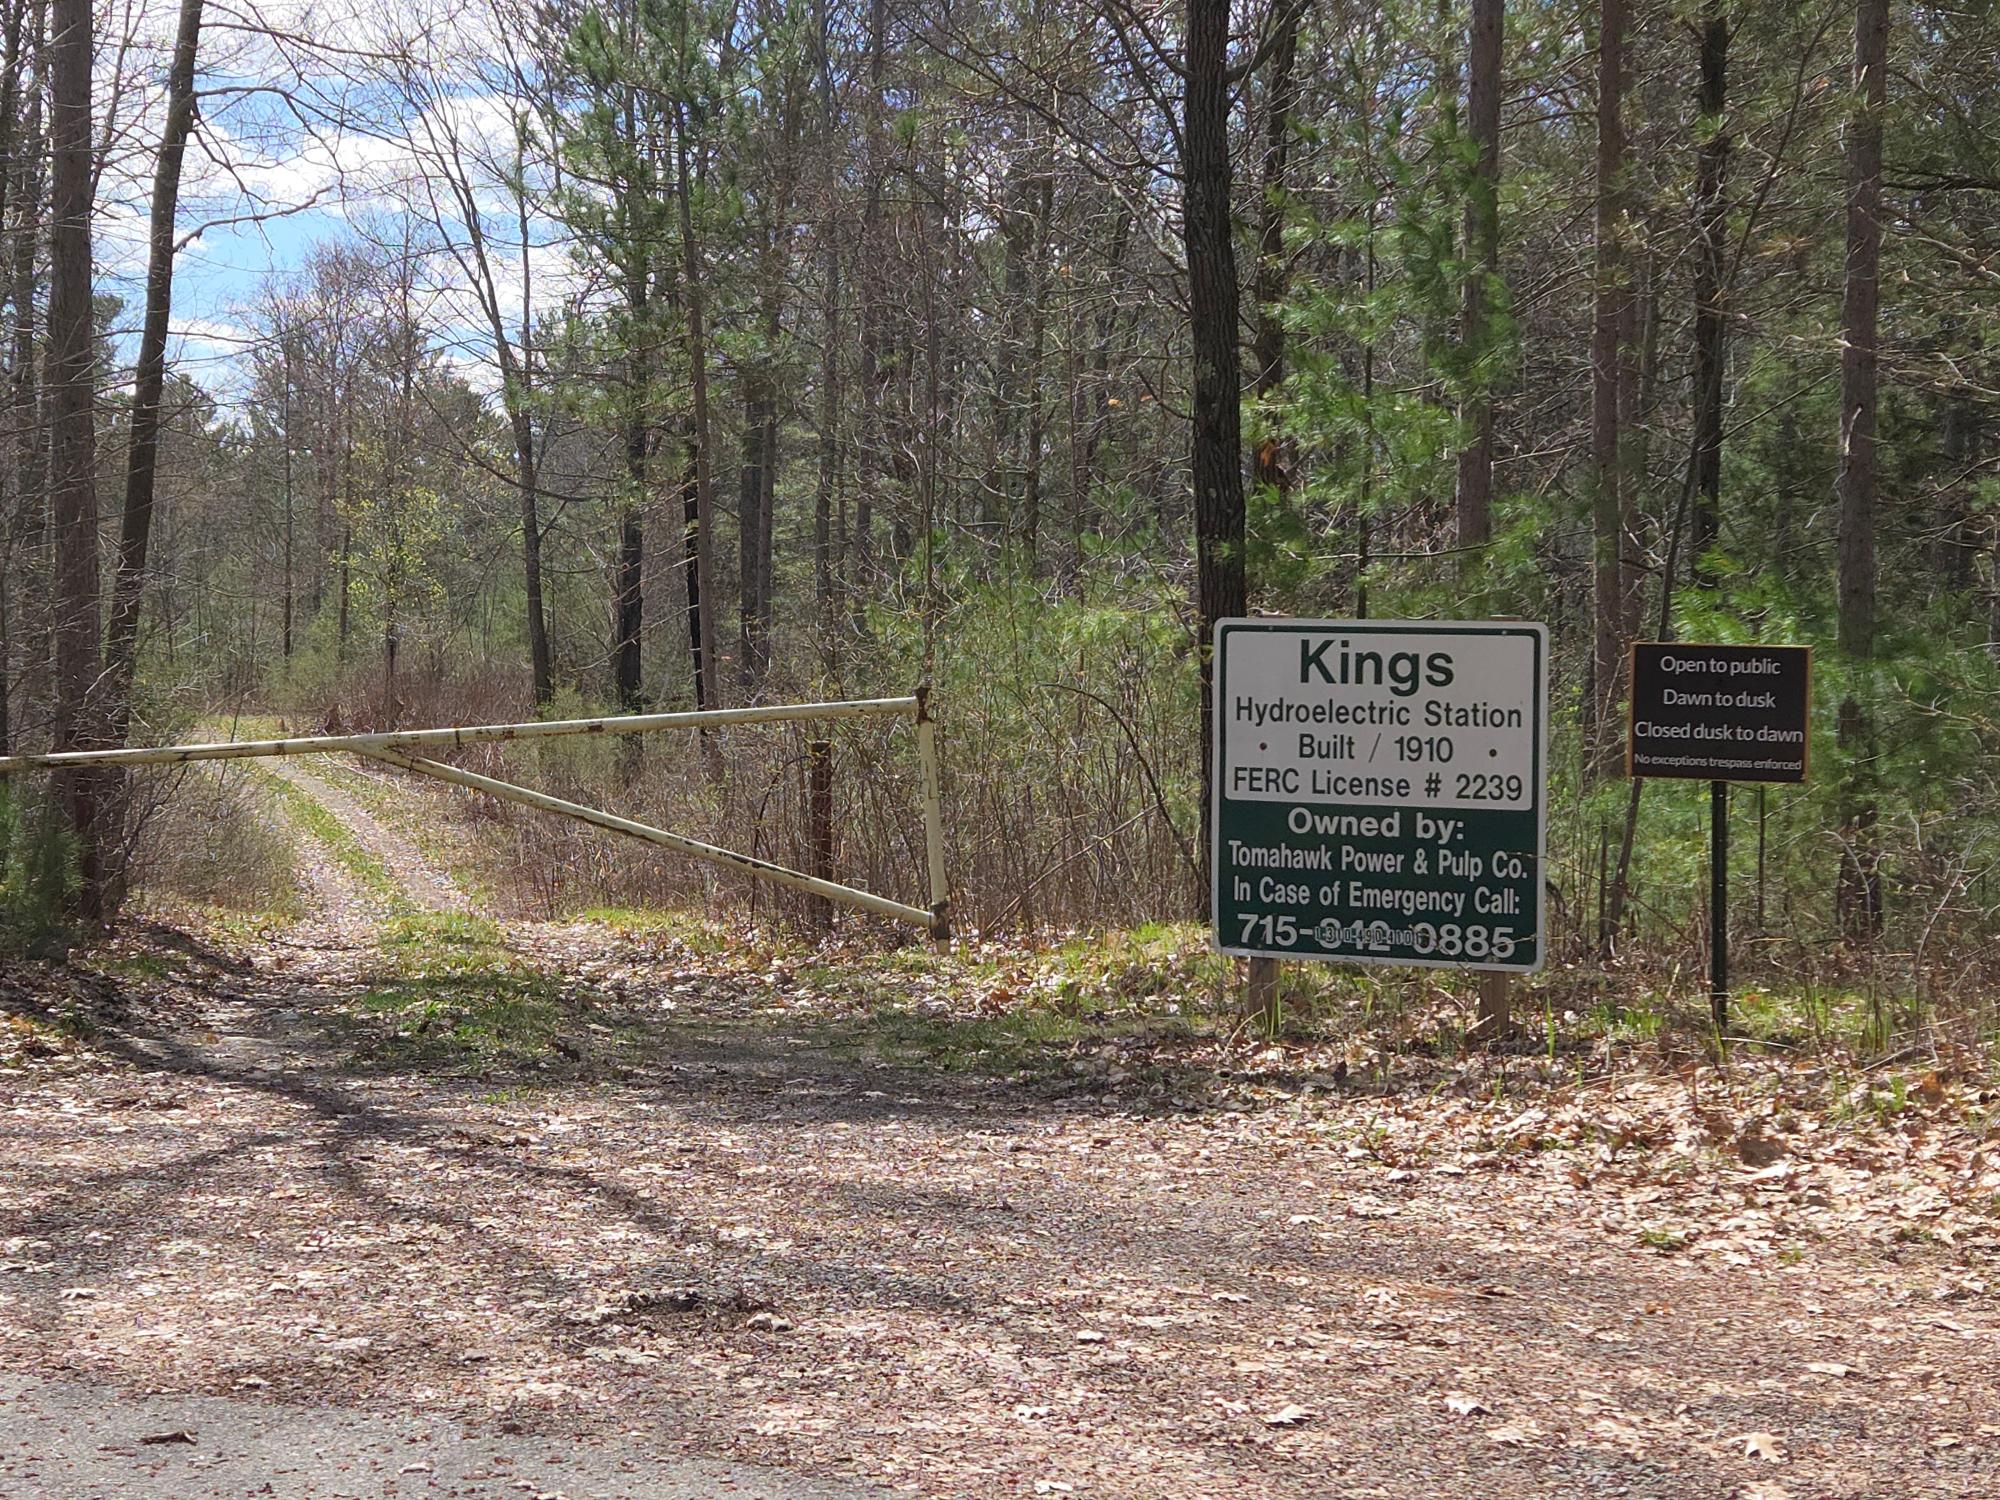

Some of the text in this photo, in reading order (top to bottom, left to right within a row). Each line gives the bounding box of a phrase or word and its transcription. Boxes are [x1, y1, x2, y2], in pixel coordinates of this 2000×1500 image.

[1300, 639, 1454, 696] Kings
[1660, 656, 1781, 676] Open to public
[1236, 697, 1521, 728] Hydroelectric Station
[1663, 689, 1776, 708] Dawn to dusk
[1635, 721, 1803, 743] Closed dusk to dawn
[1299, 734, 1355, 759] Built
[1395, 736, 1453, 763] 1910
[1635, 754, 1801, 770] No exceptions trespass enforced
[1234, 767, 1521, 800] FERC License # 2239
[1288, 807, 1465, 844] Owned by:
[1228, 841, 1527, 881] Tomahawk Power & Pulp Co.
[1234, 876, 1520, 917] In Case of Emergency Call:
[1237, 913, 1514, 958] 715-3420885
